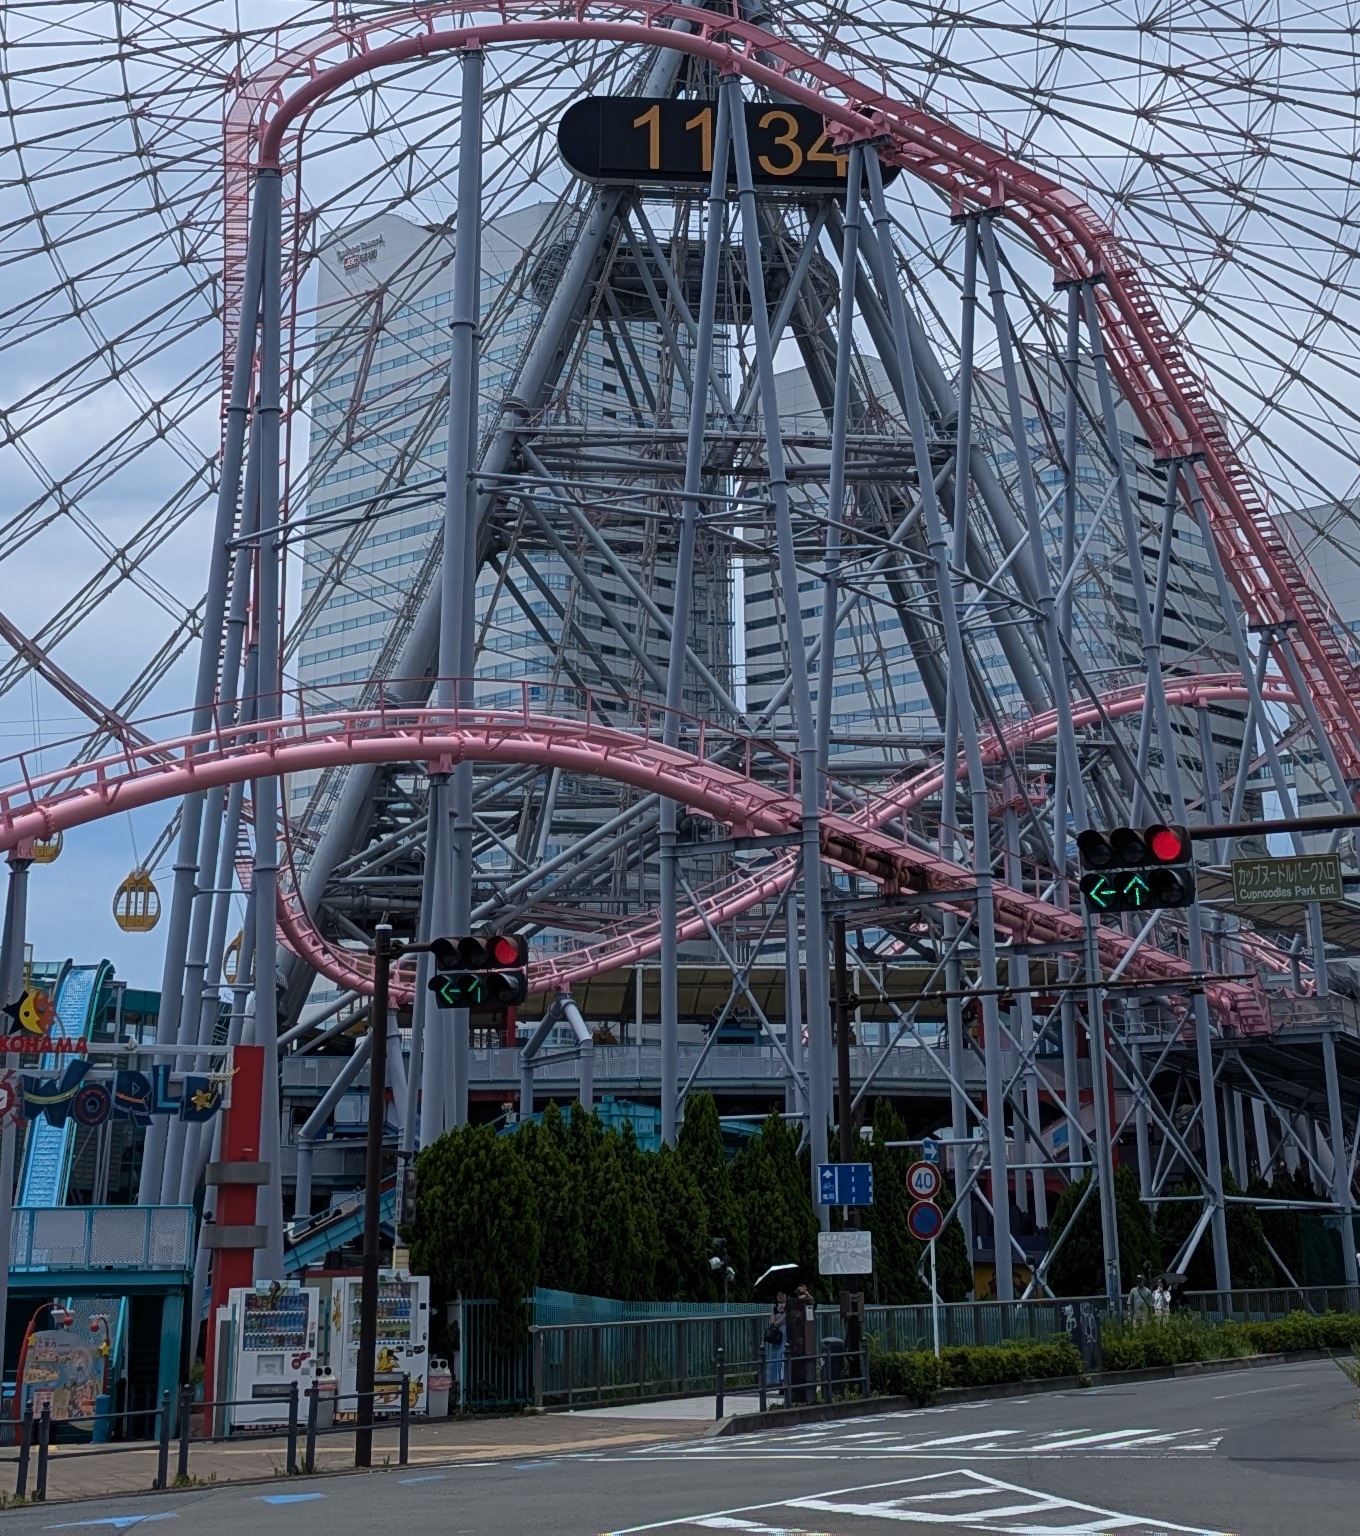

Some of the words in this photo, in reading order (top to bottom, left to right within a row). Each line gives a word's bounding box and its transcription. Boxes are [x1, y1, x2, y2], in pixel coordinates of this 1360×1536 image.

[1238, 861, 1336, 885] カップヌードルパーク入口
[1240, 886, 1292, 901] Cupnoodles
[1295, 883, 1317, 896] Park
[1320, 882, 1338, 895] Ent.
[20, 1058, 223, 1128] WORLD
[915, 1172, 933, 1189] 40
